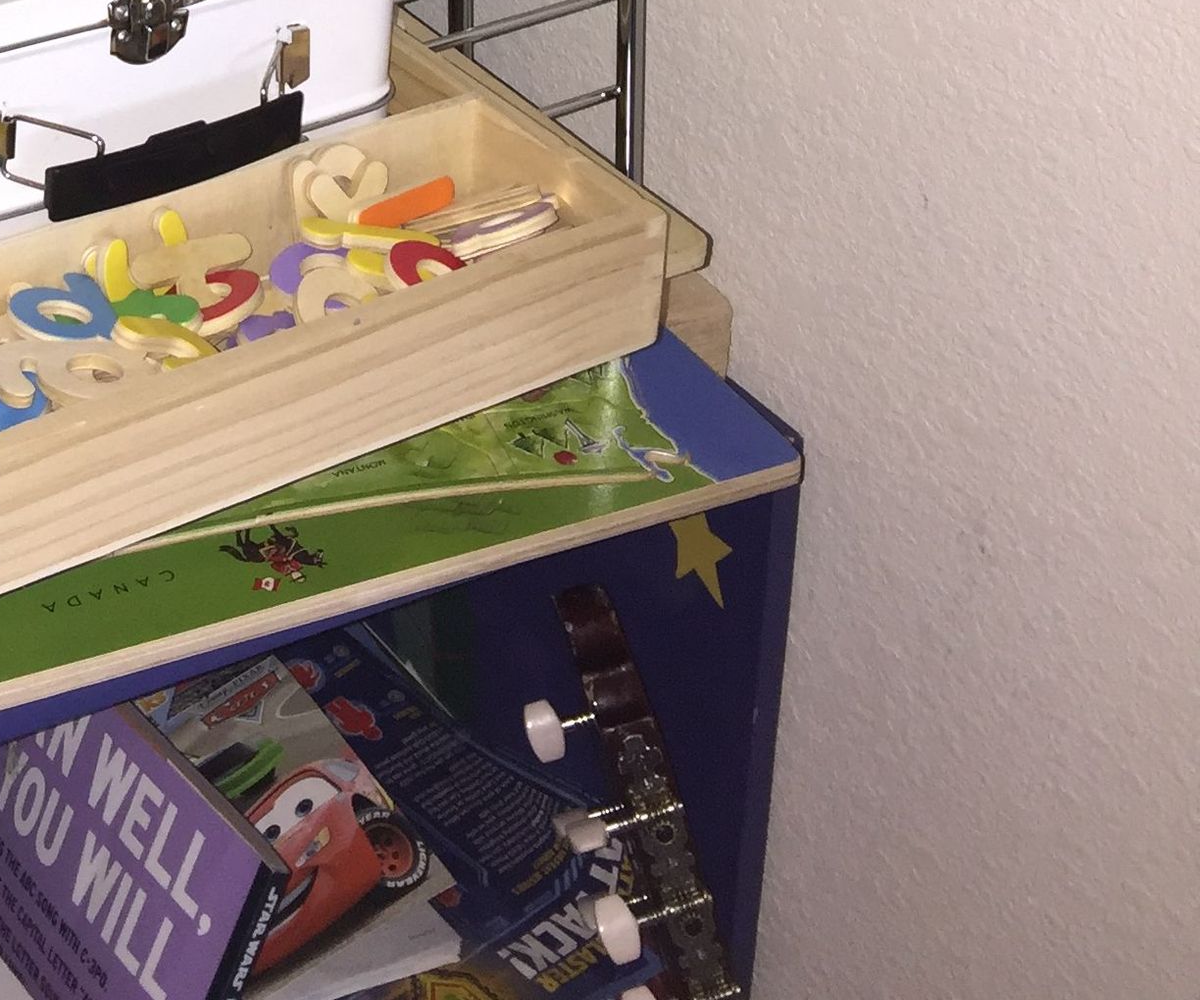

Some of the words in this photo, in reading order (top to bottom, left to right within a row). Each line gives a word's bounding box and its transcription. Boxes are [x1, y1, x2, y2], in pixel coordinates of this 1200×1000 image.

[331, 458, 387, 479] MONTANA
[41, 569, 176, 613] CANADA
[88, 732, 212, 937] WELL,
[1, 884, 19, 913] THE
[46, 946, 80, 994] LETTER
[3, 847, 22, 878] THE
[18, 871, 38, 898] ABC
[35, 891, 60, 927] SONG
[57, 918, 82, 955] WITH
[71, 829, 174, 1000] WILL
[253, 886, 280, 939] STAR
[232, 936, 258, 992] WARS
